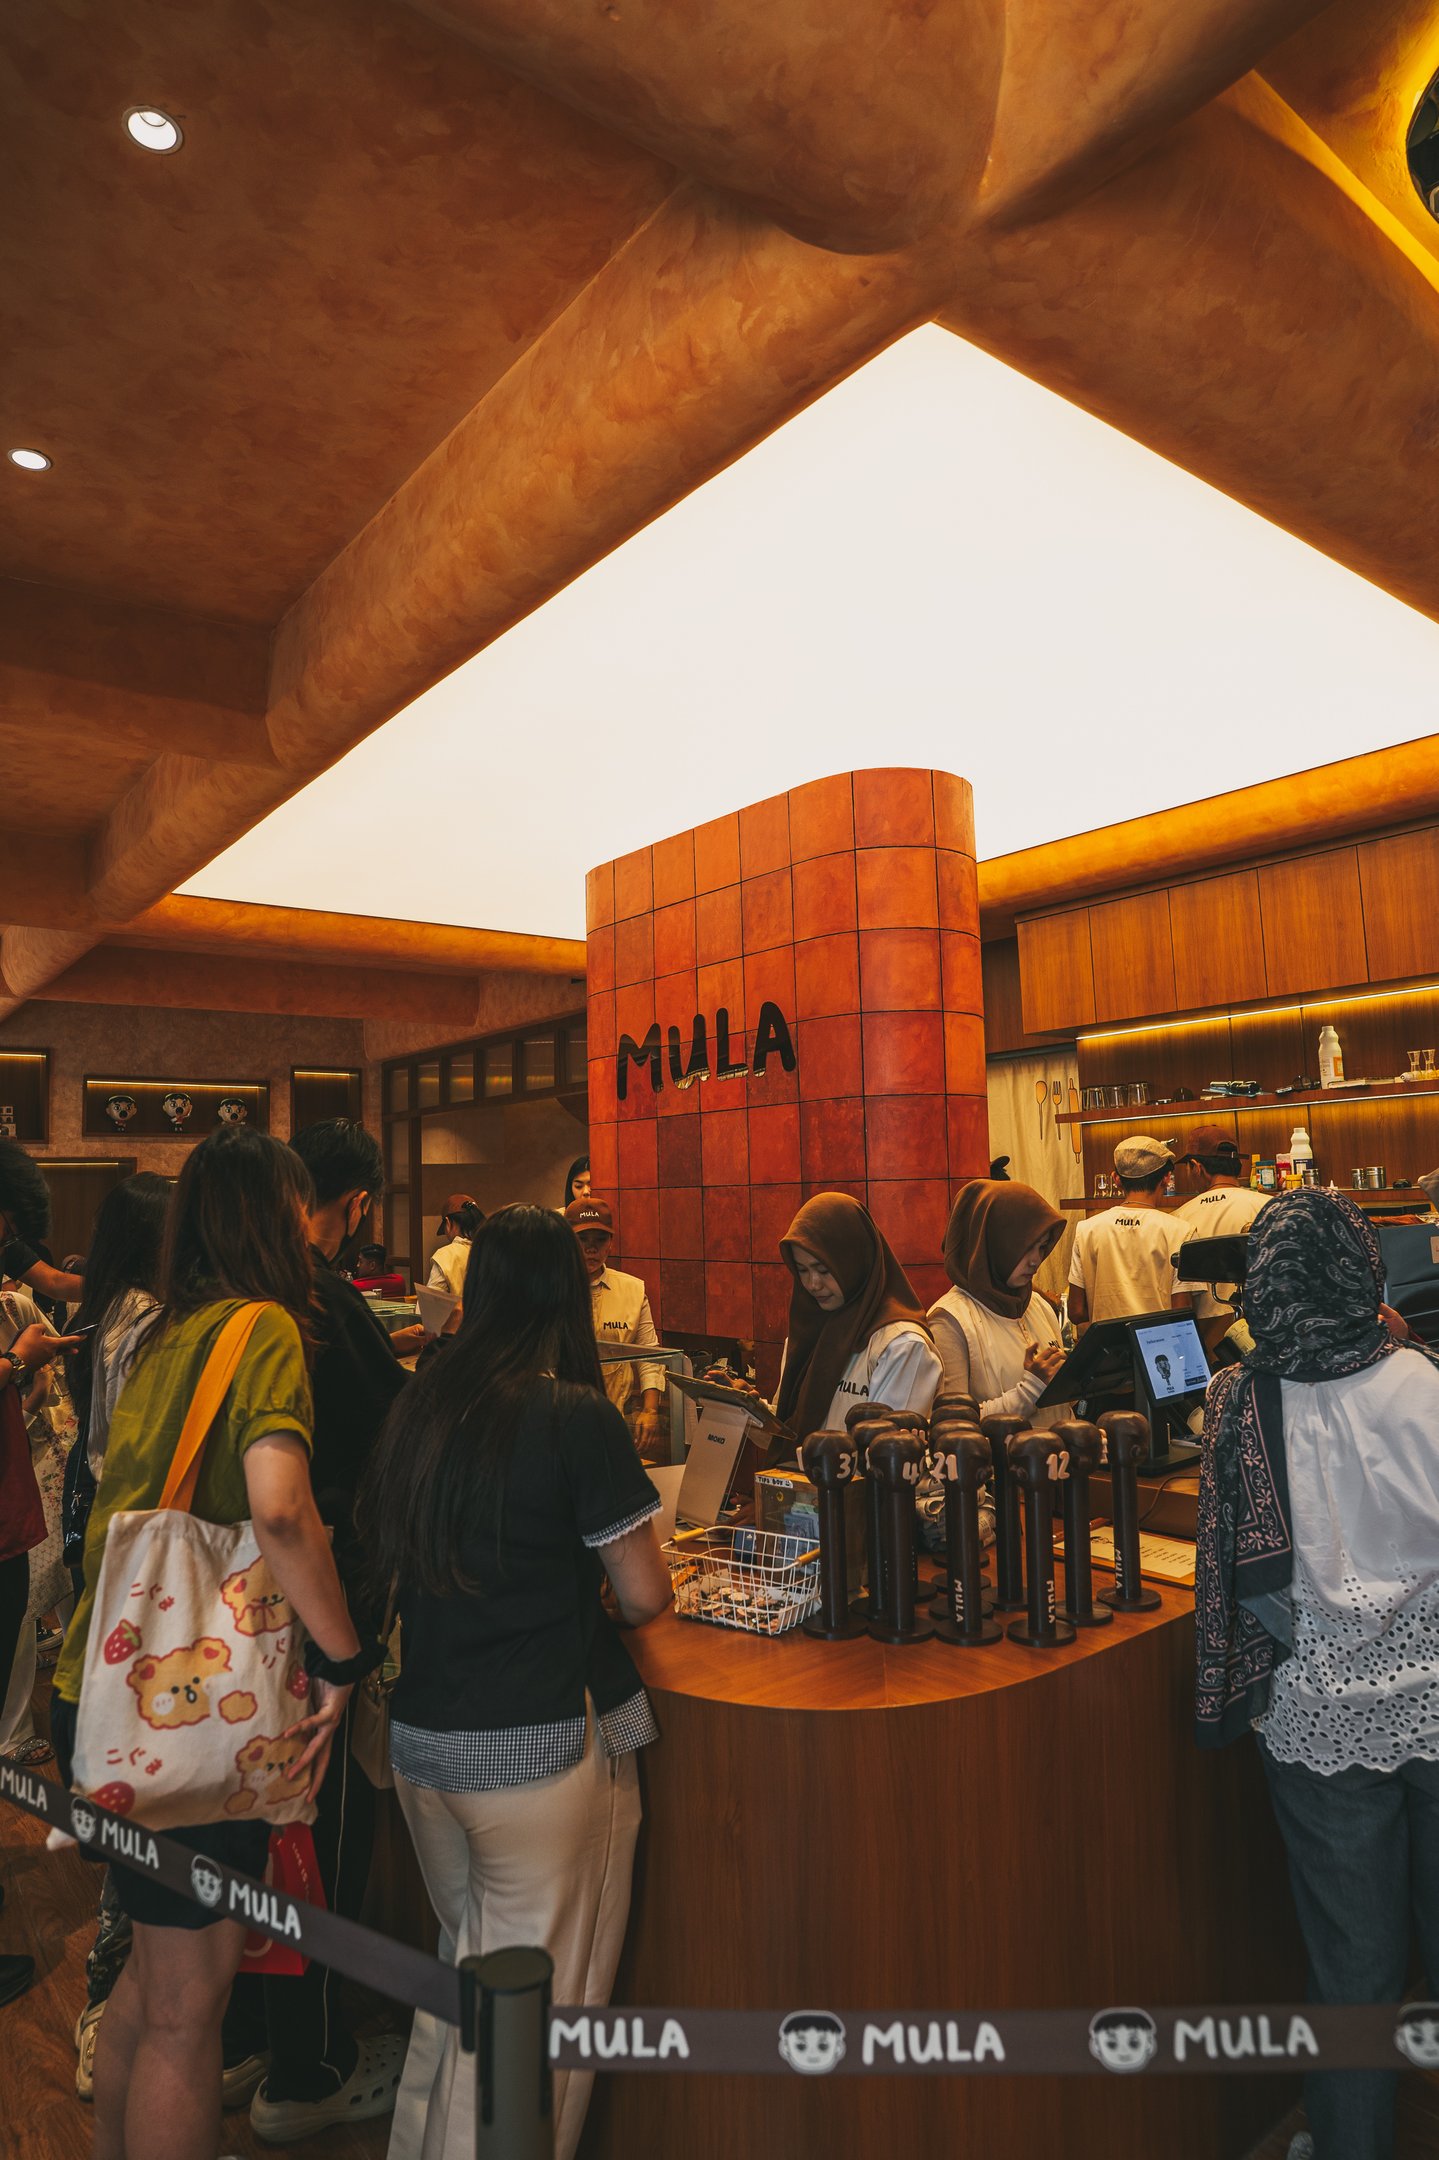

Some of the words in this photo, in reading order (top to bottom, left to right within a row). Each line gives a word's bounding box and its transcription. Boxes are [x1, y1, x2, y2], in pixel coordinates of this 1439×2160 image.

[617, 1001, 796, 1100] MULA
[1200, 1194, 1226, 1204] MULA
[603, 1321, 629, 1330] MULA
[930, 1451, 959, 1481] 21
[1045, 1450, 1070, 1481] 12
[1114, 1548, 1124, 1589] MULA
[953, 1579, 965, 1623] MULA
[1046, 1580, 1056, 1624] MULA
[0, 1766, 48, 1811] MULA
[101, 1818, 160, 1869] MULA
[228, 1879, 302, 1940] MULA
[548, 2016, 690, 2060] MULA
[862, 2021, 1006, 2065] MULA
[1173, 2014, 1320, 2062] MULA
